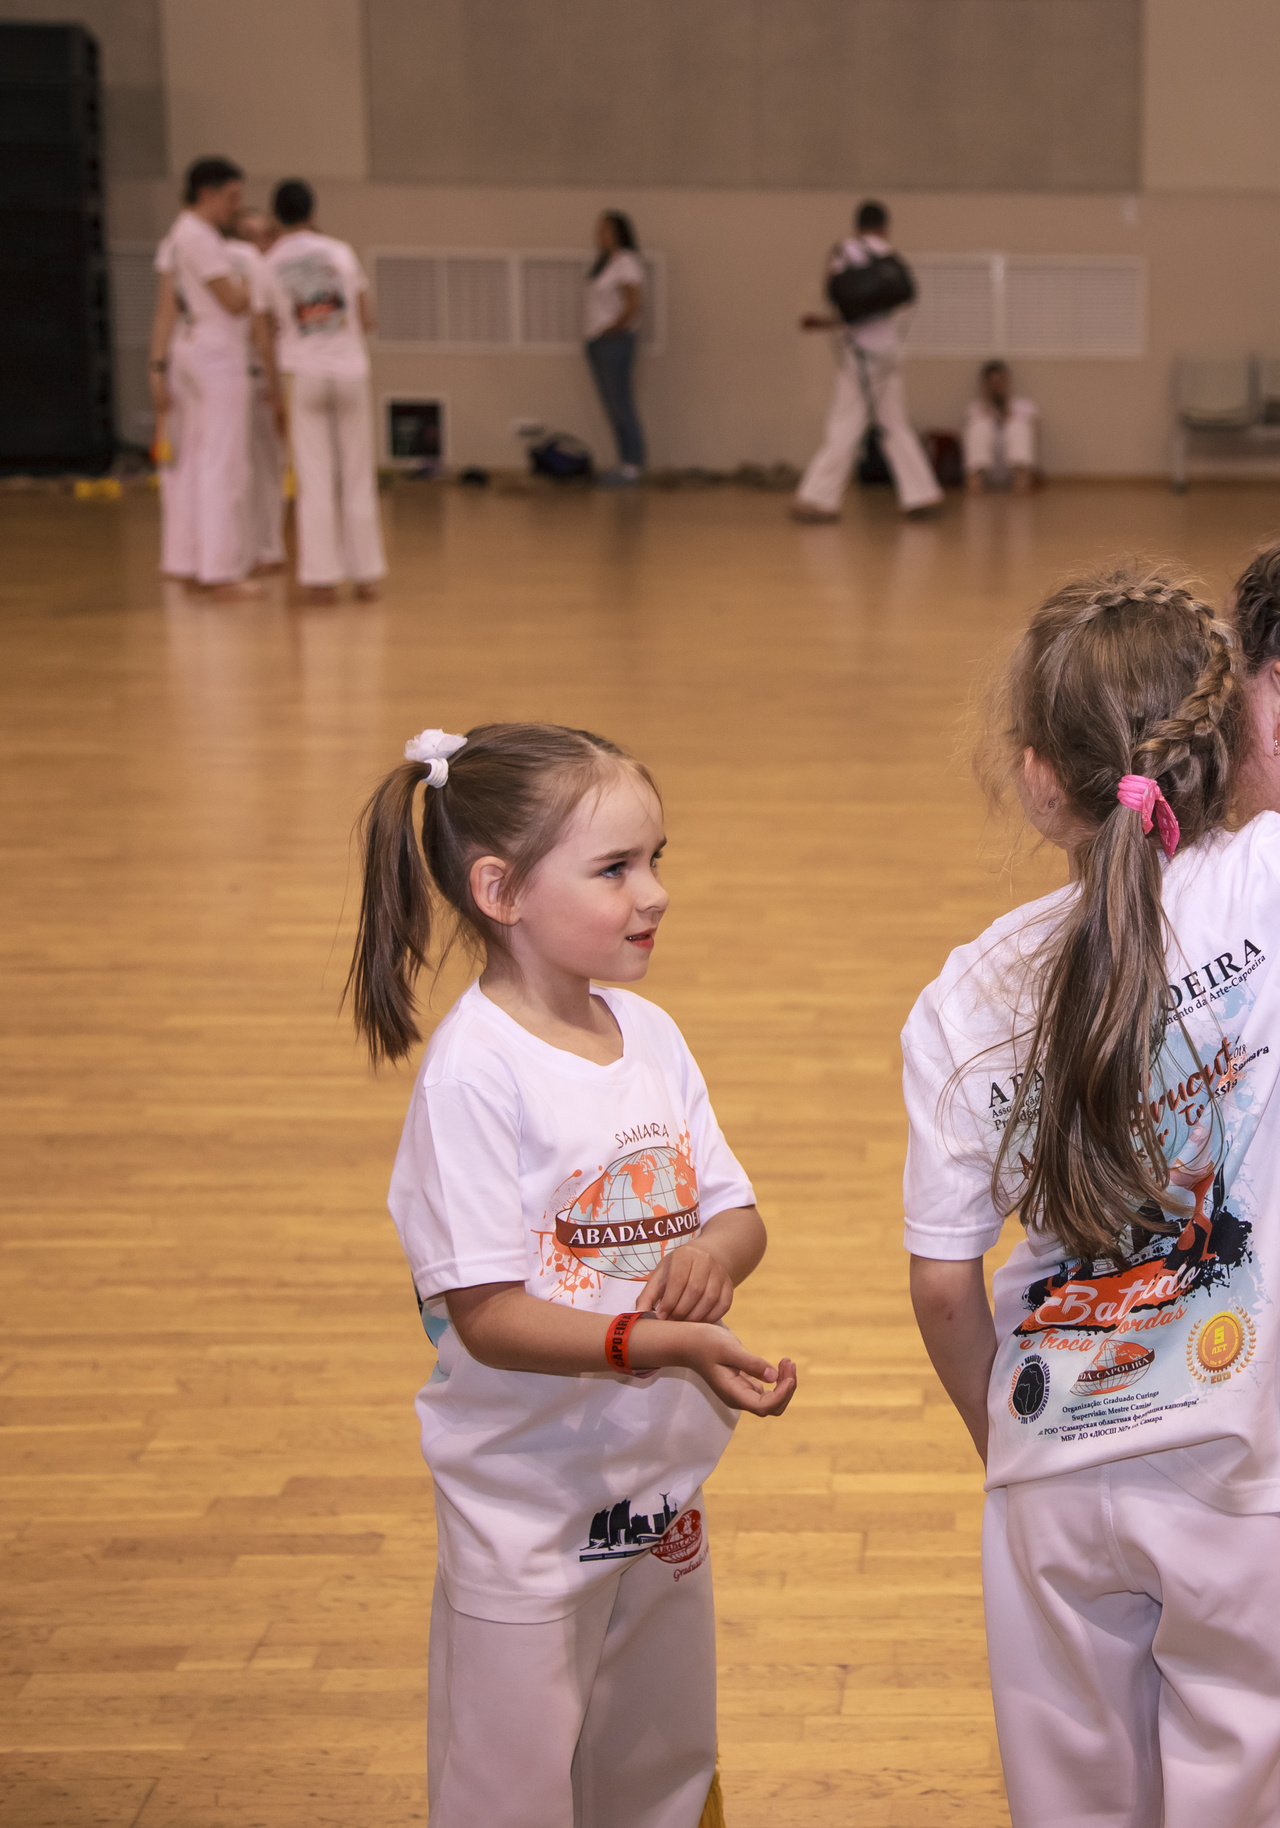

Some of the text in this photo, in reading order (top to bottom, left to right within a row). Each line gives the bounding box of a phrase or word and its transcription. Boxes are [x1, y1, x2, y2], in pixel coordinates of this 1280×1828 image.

[1195, 998, 1208, 1010] da
[1209, 955, 1266, 1002] Arte-Capoeira
[614, 1122, 670, 1149] SAMARA
[1040, 1329, 1096, 1353] Troca
[1118, 1305, 1187, 1335] ordas
[1213, 1326, 1225, 1345] 5
[611, 1314, 634, 1368] CAPOEIRA
[1062, 1400, 1102, 1414] Organização:
[1103, 1394, 1135, 1406] Graduado
[1071, 1409, 1108, 1422] Supervisão:
[1108, 1406, 1130, 1416] Mestre
[1061, 1434, 1077, 1442] МБУ
[1078, 1432, 1089, 1440] ДО
